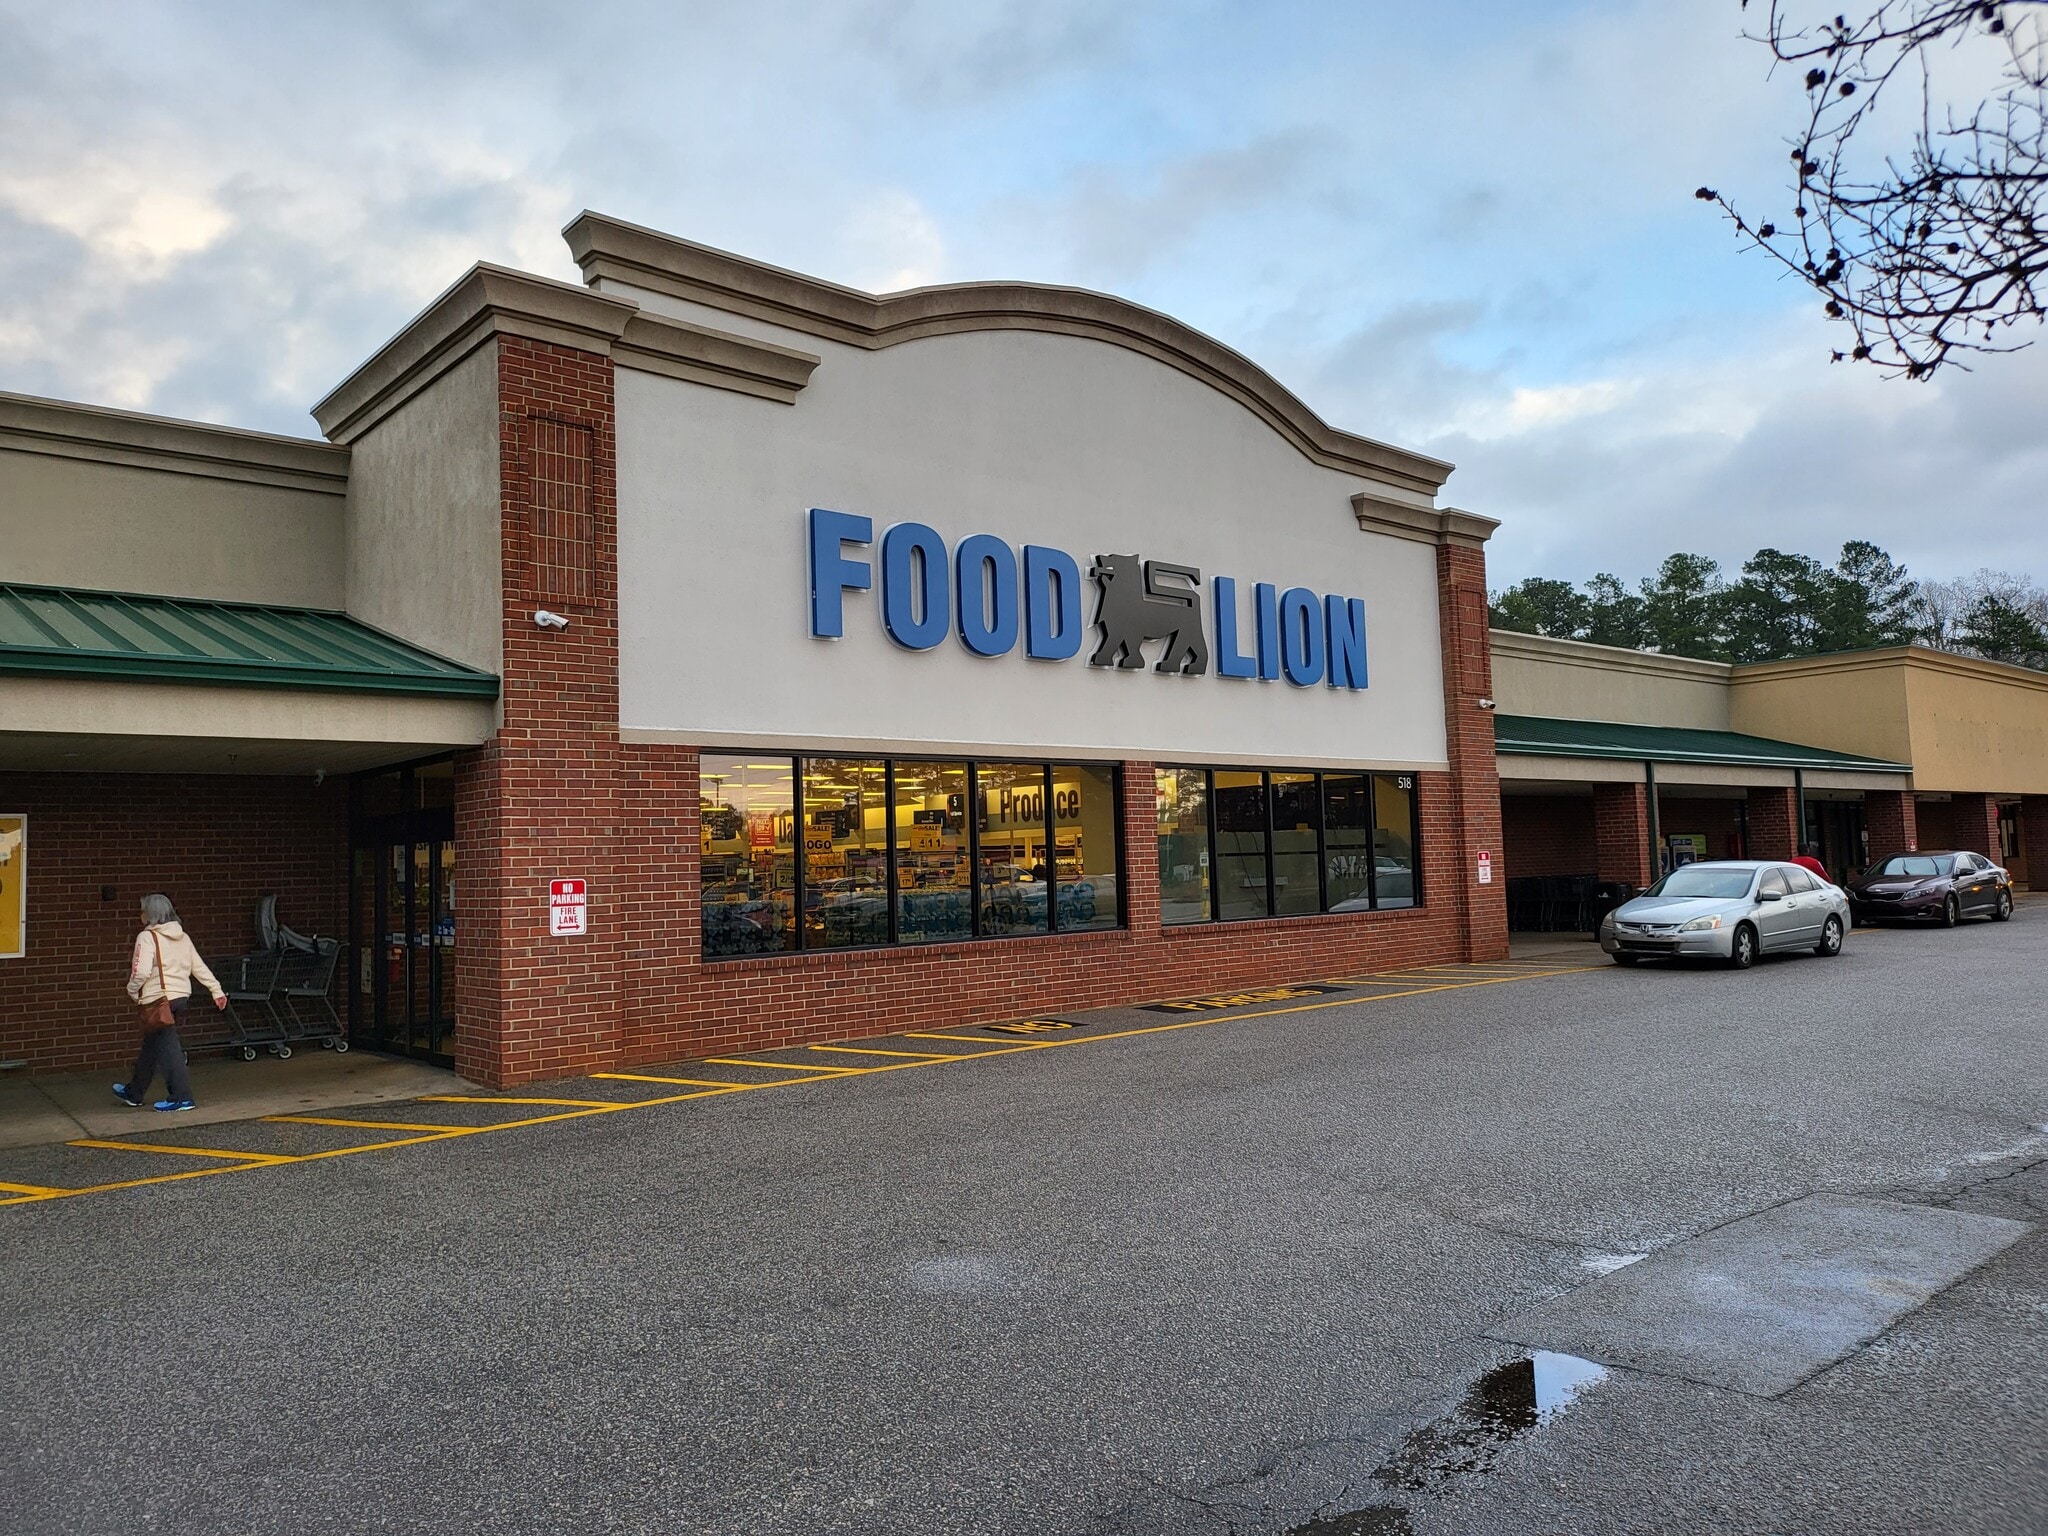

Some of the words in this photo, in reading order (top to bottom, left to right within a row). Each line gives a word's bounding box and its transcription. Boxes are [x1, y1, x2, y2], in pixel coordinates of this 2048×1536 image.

[807, 508, 1083, 659] FOOD
[1211, 575, 1369, 689] LION
[1398, 777, 1412, 789] 518
[1000, 790, 1079, 823] Prodce
[804, 840, 831, 849] OGO
[563, 883, 573, 893] NO
[552, 893, 584, 904] PARKING
[560, 907, 577, 915] FIRE
[559, 915, 578, 924] LANE
